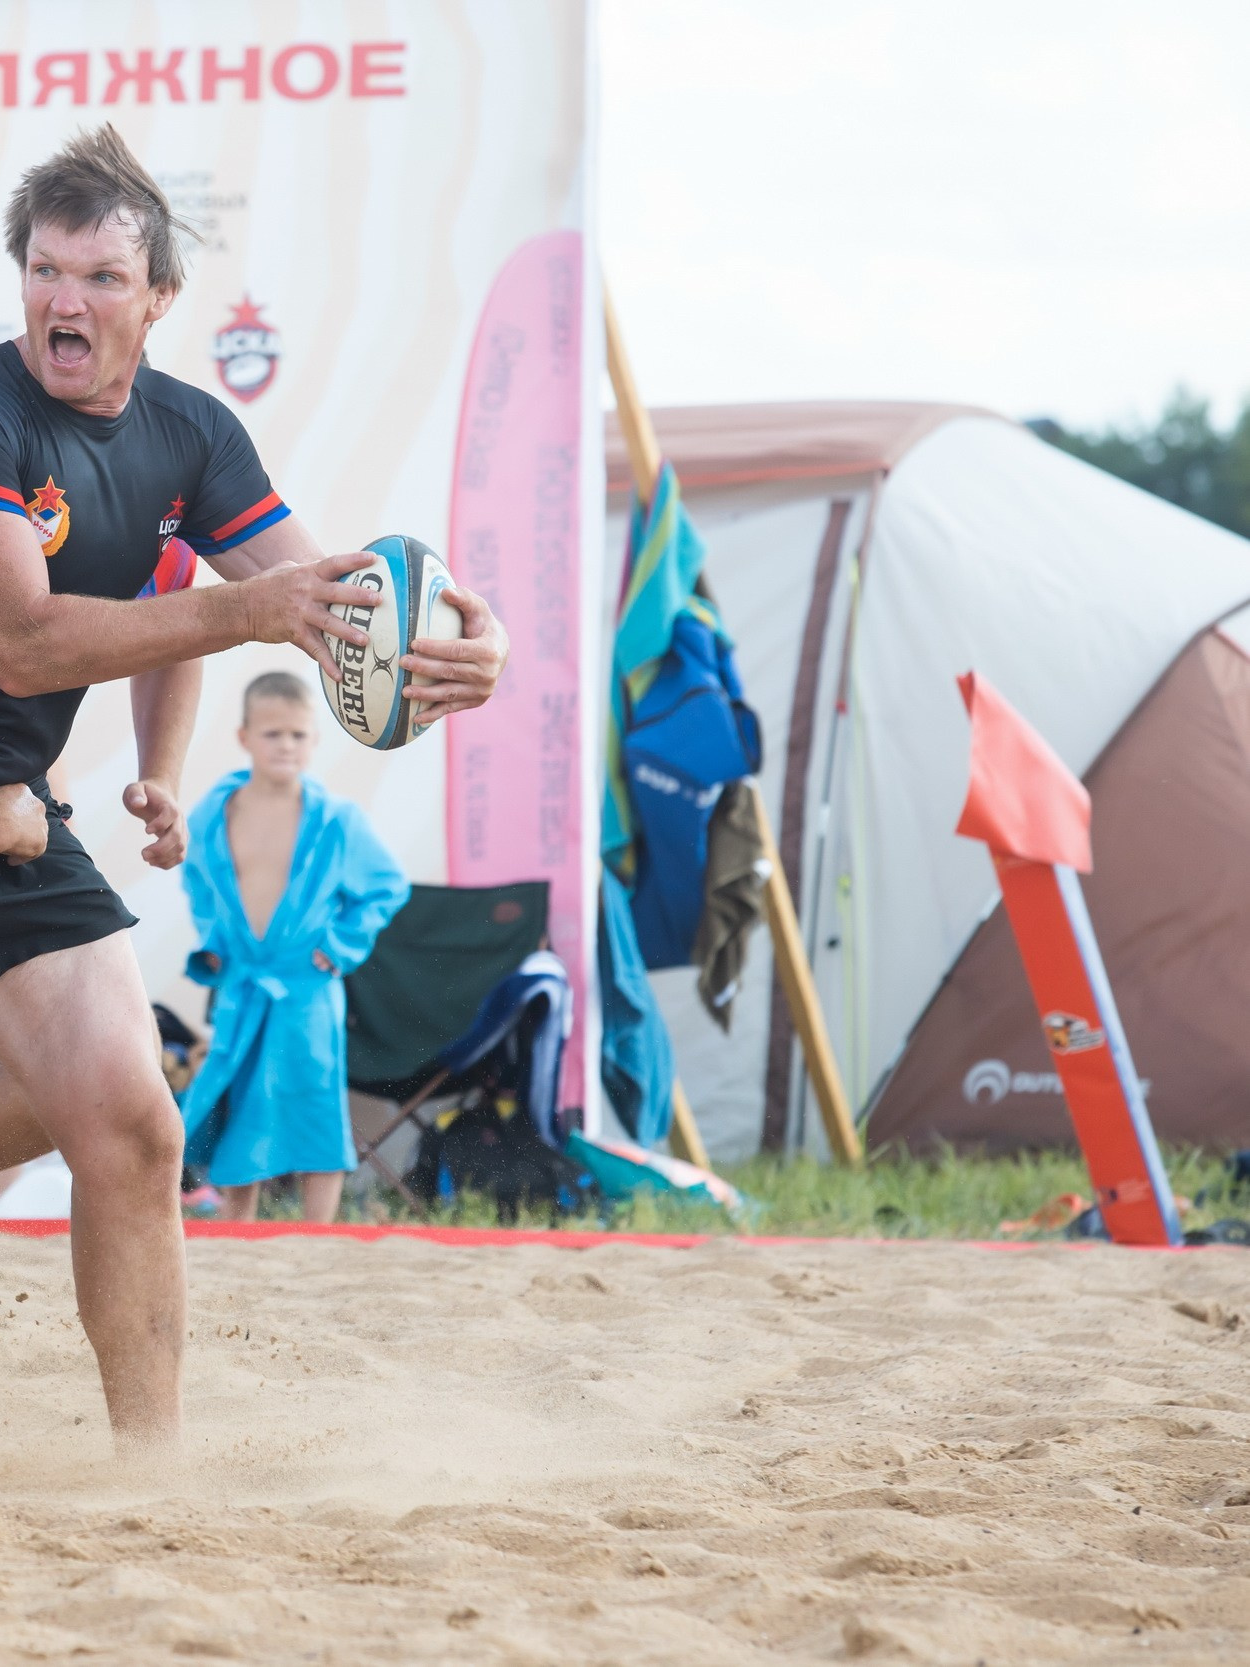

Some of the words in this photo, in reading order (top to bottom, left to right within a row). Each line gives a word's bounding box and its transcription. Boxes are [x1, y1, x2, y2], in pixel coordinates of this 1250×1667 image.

[33, 520, 53, 538] ЦСКА
[158, 519, 181, 535] ЦСК
[341, 572, 384, 735] GILBERT
